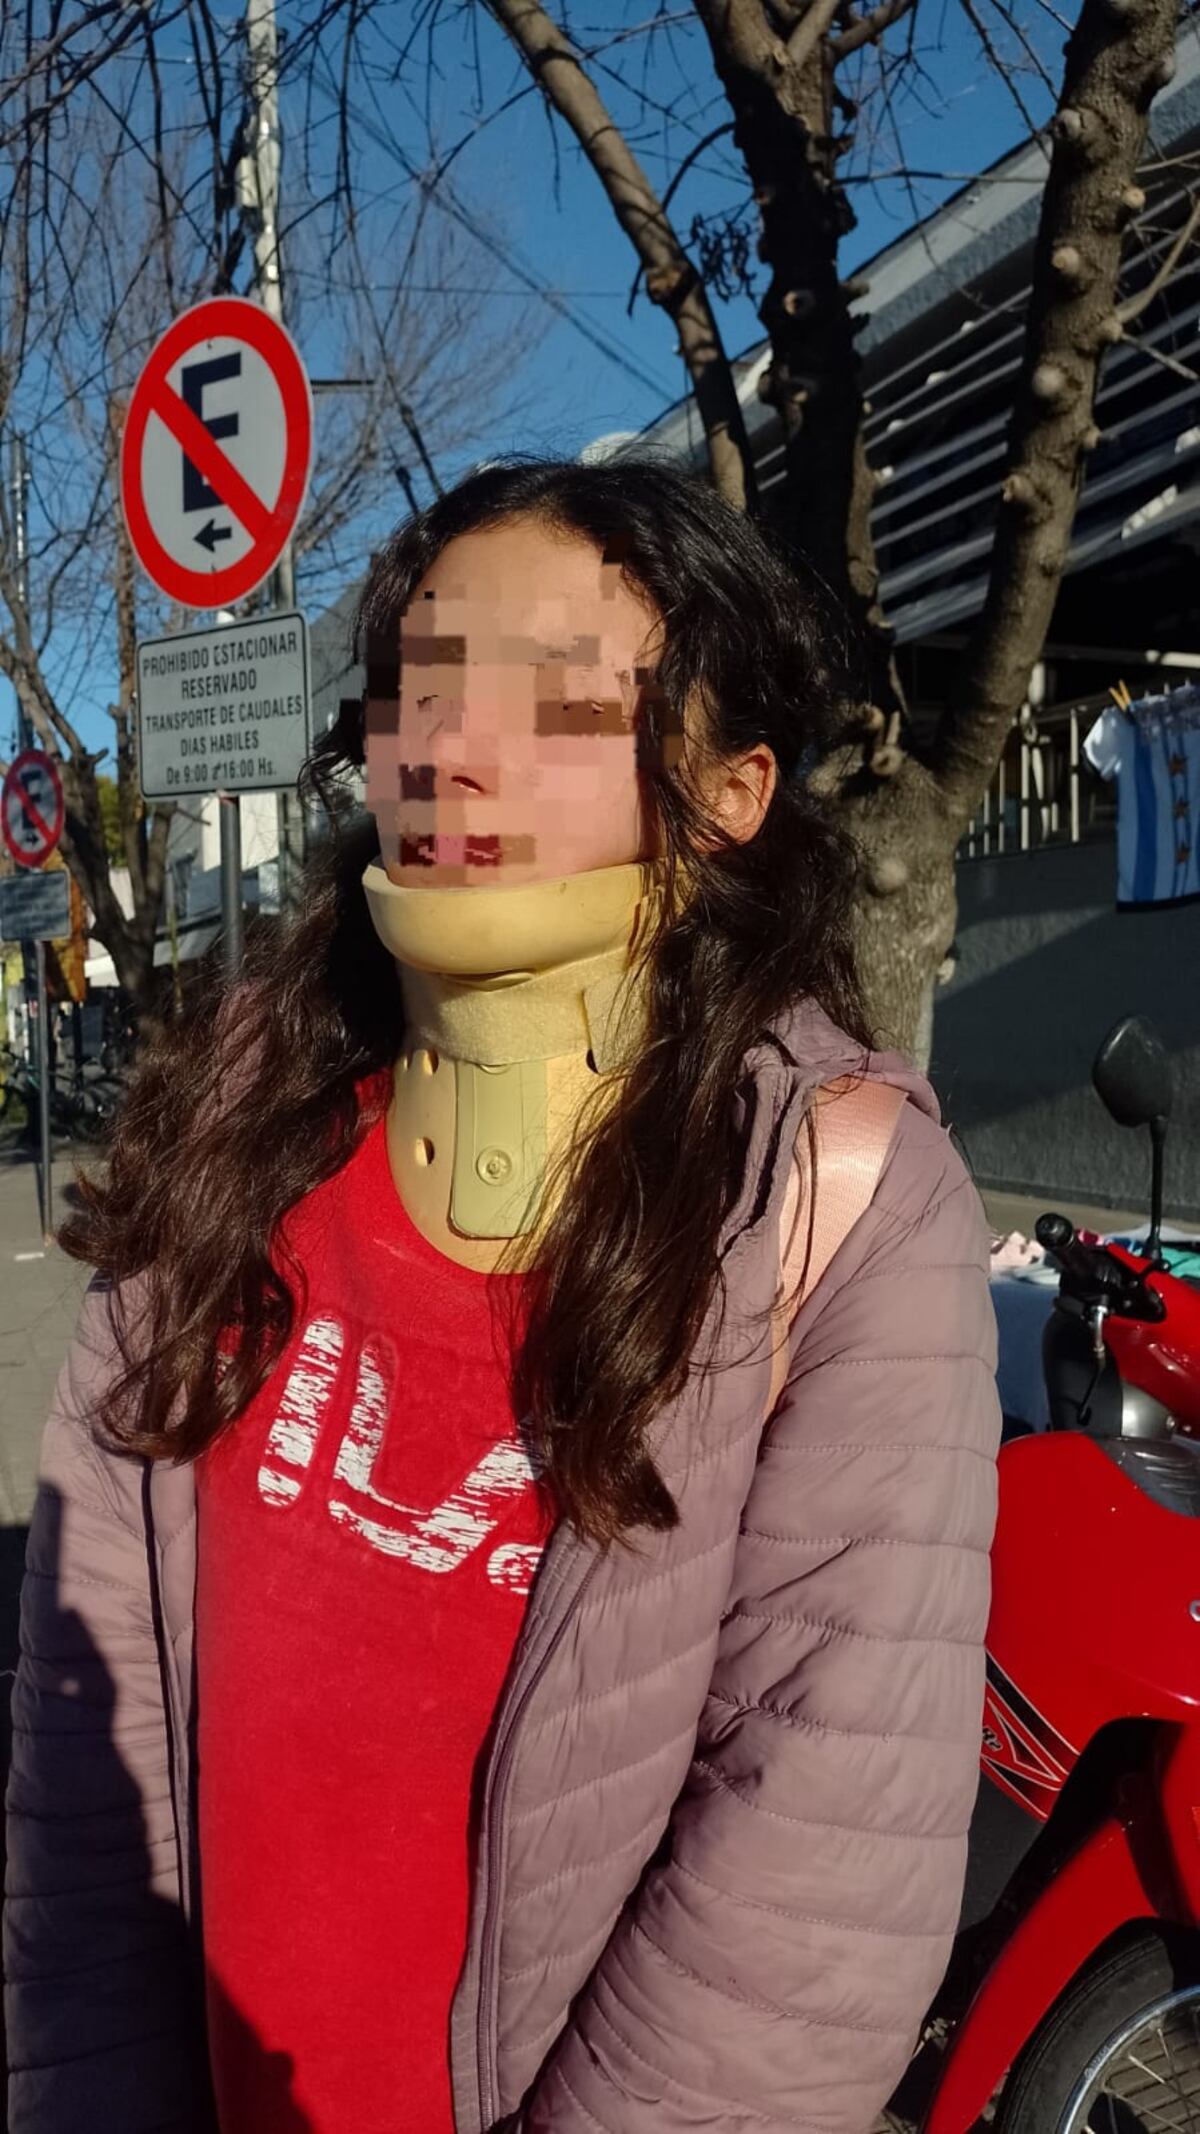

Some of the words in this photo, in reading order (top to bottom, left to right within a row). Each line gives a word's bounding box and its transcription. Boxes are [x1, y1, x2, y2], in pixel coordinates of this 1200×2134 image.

[182, 352, 241, 513] E
[143, 648, 209, 677] PROHIBIDO
[214, 632, 297, 666] ESTACIONAR
[181, 669, 257, 700] RESERVADO
[146, 707, 216, 733] TRANSPORTE
[220, 704, 235, 725] DE
[239, 696, 303, 723] CAUDALES
[181, 736, 206, 757] DIAS
[210, 729, 259, 752] HABILES
[166, 767, 180, 785] De
[183, 763, 208, 783] 9:00
